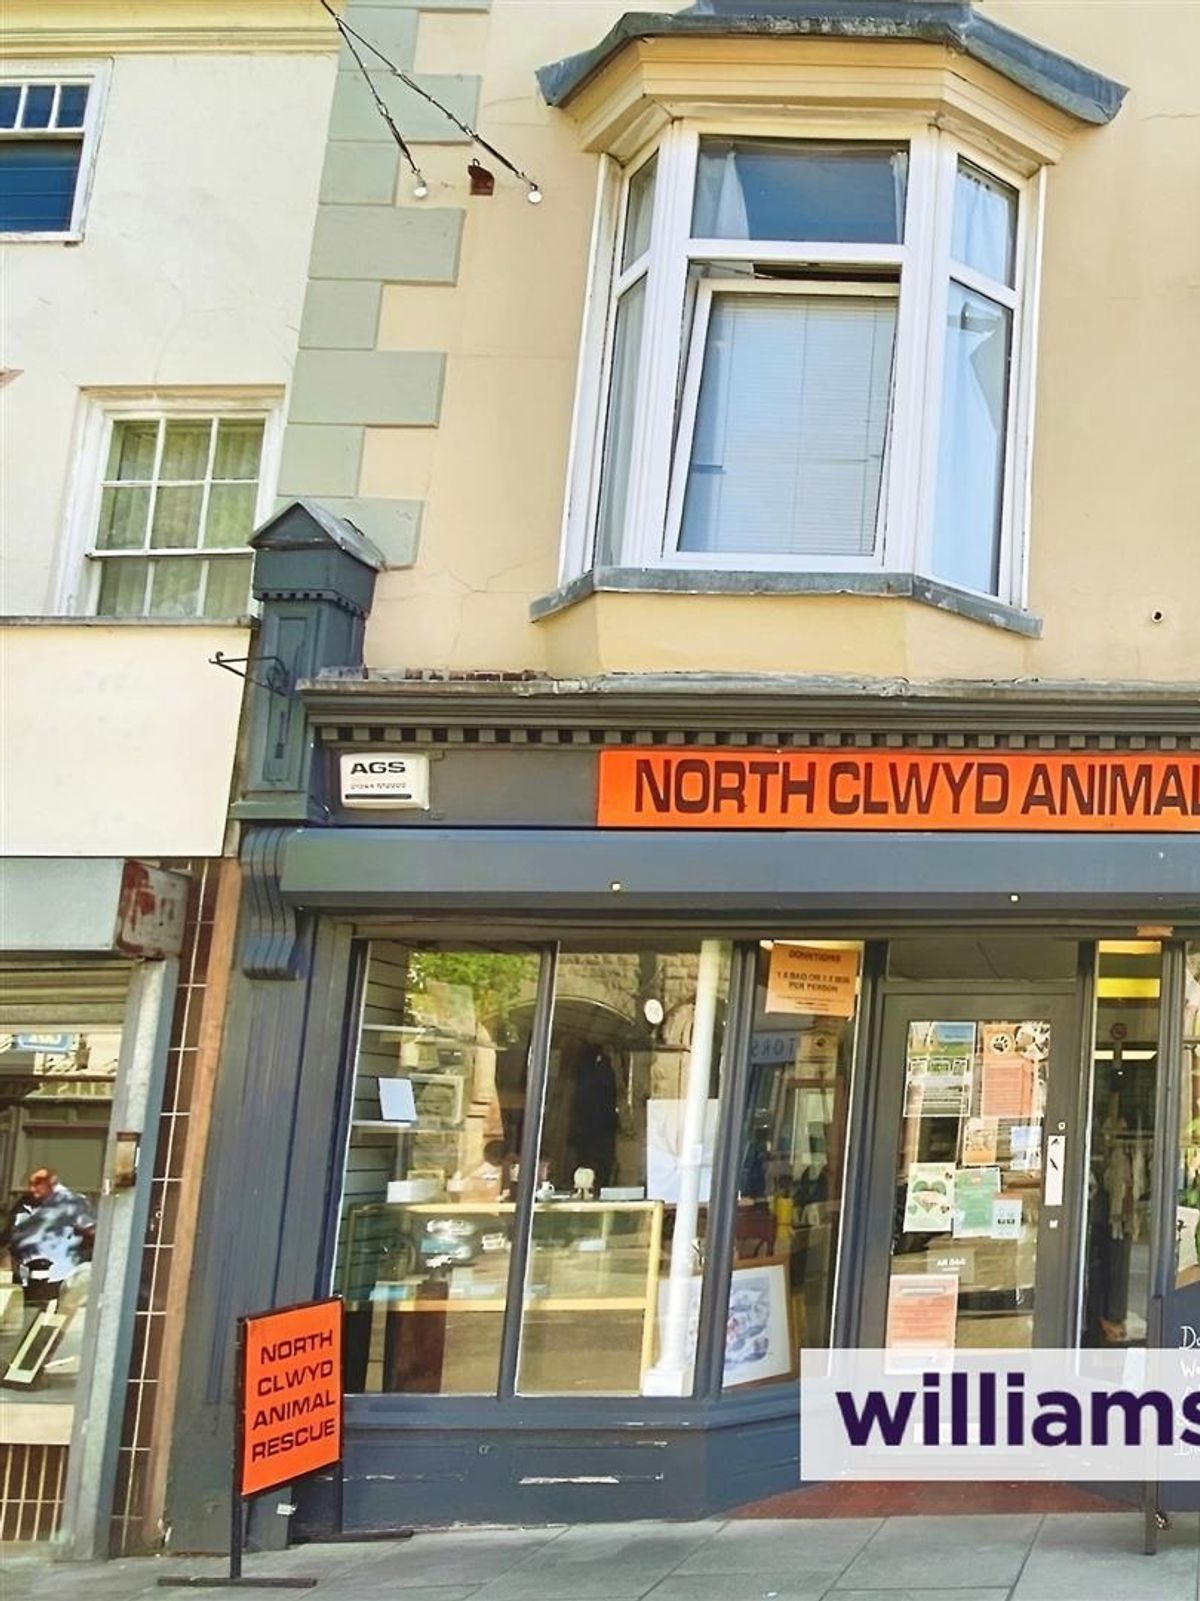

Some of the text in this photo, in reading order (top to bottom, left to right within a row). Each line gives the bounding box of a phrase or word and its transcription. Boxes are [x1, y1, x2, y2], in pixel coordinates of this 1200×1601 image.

[350, 761, 406, 775] AGS
[634, 759, 817, 815] NORTH
[827, 762, 1009, 816] CLWYD
[260, 1329, 333, 1365] NORTH
[257, 1360, 333, 1396] CLWYD
[252, 1390, 336, 1431] ANIMAL
[251, 1418, 336, 1462] RESCUE
